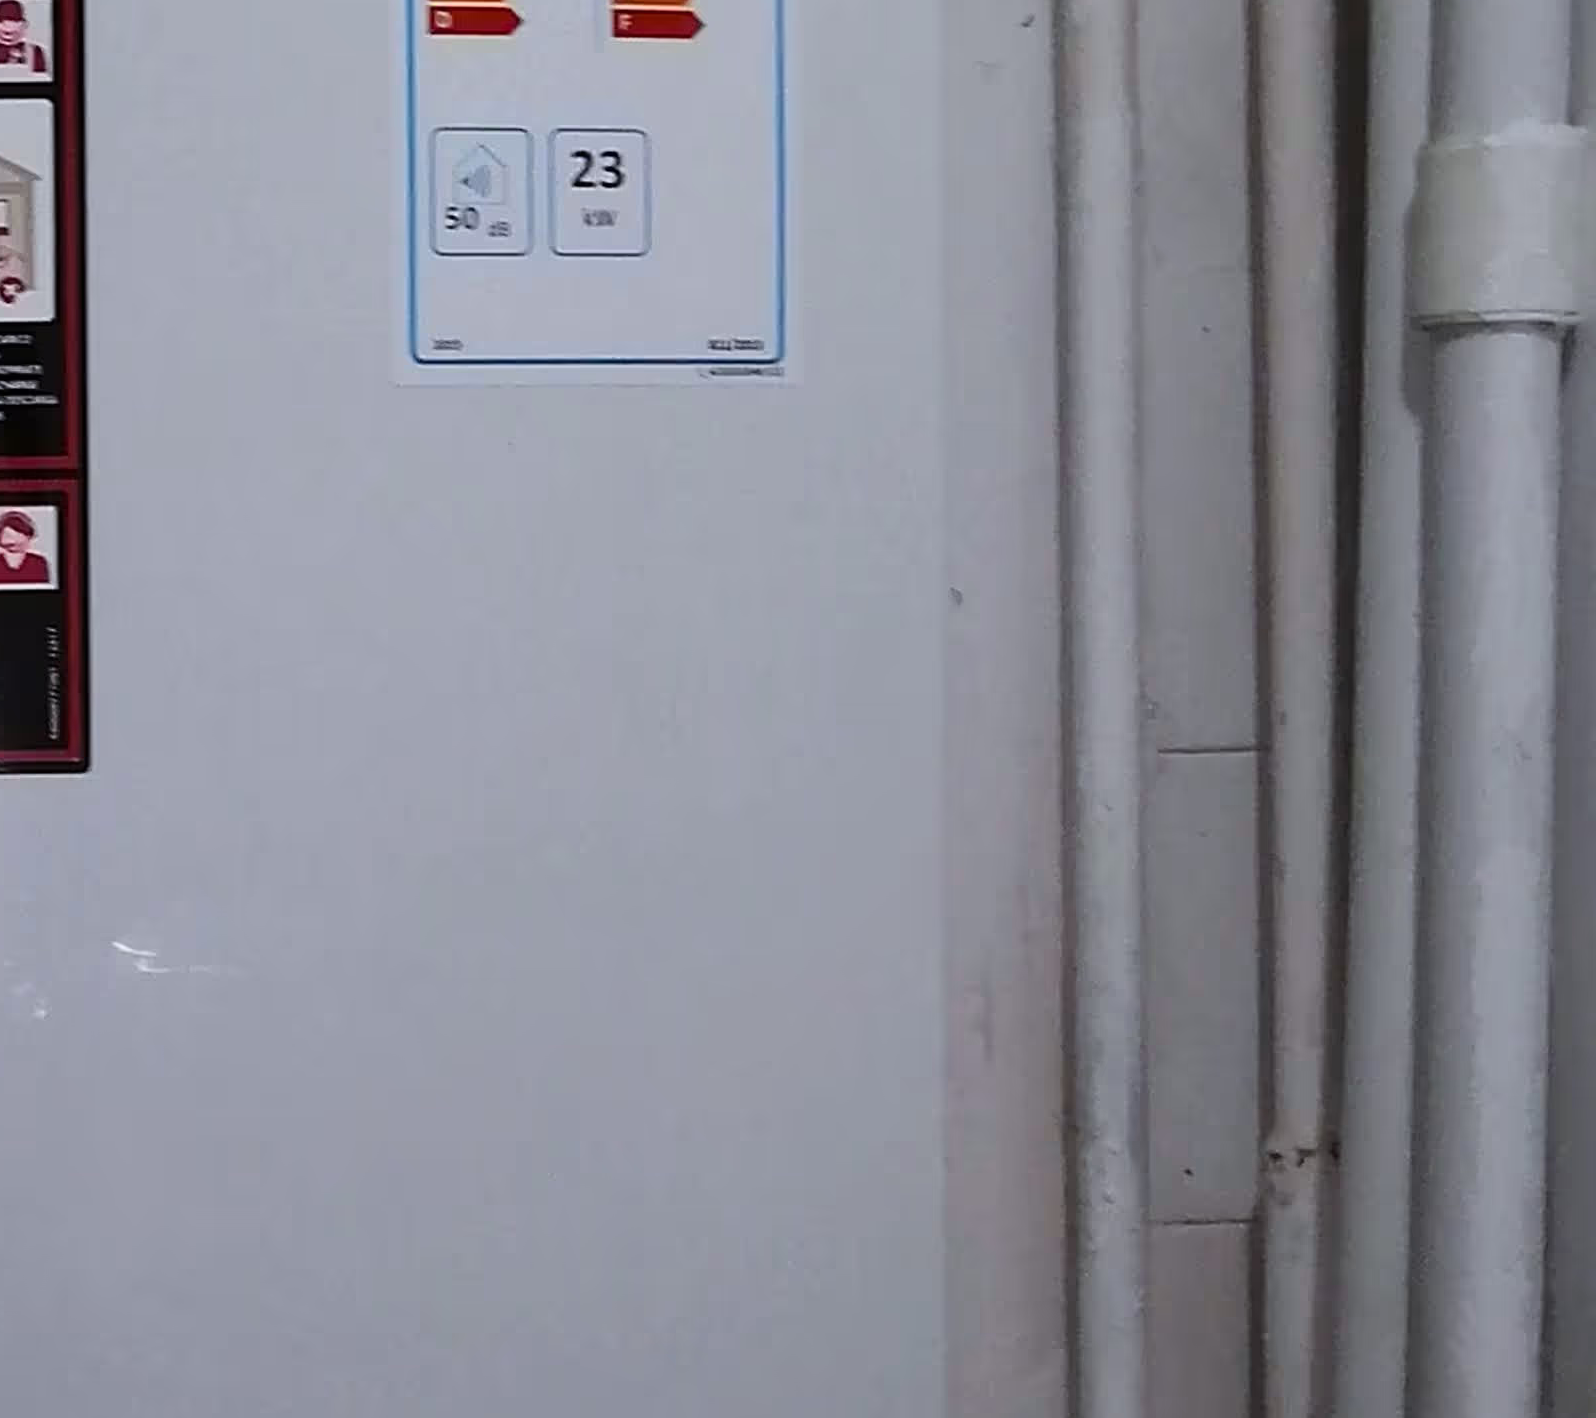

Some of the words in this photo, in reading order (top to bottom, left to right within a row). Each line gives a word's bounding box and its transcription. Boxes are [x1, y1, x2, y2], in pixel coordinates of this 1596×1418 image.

[617, 13, 634, 31] F
[570, 149, 626, 189] 23
[445, 206, 481, 231] 50
